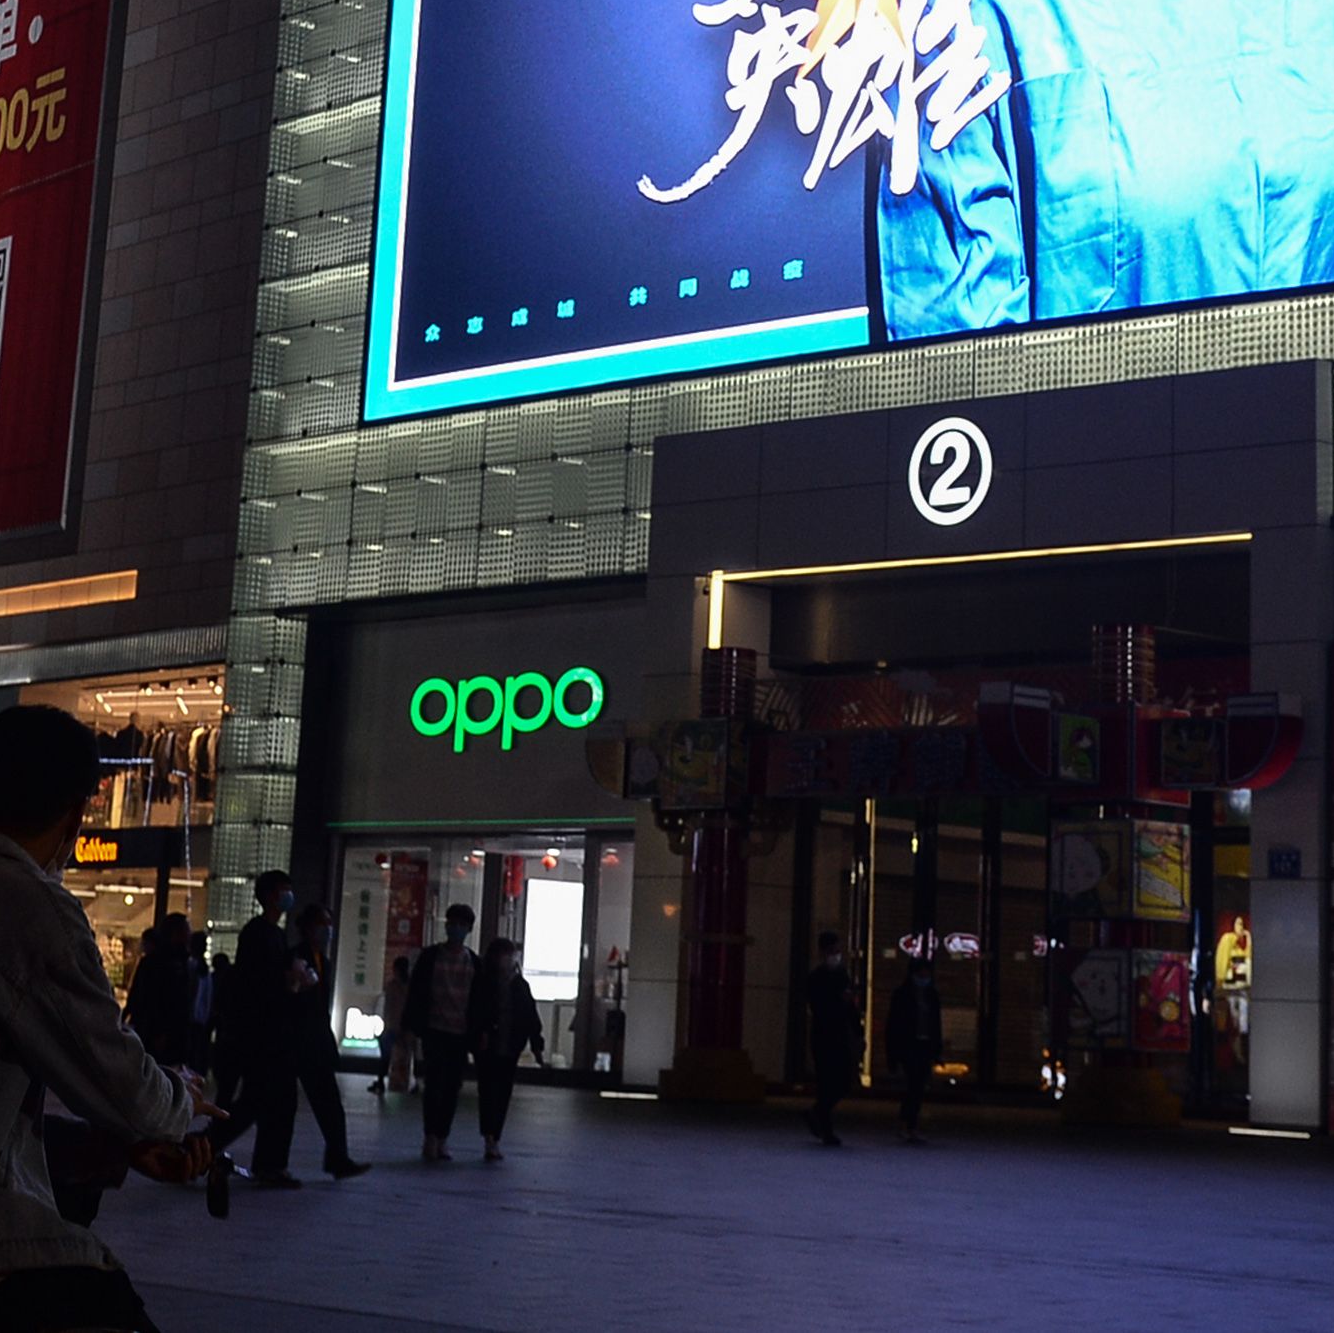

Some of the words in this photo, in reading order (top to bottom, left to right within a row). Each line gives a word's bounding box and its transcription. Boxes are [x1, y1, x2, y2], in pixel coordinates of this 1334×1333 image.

[424, 298, 576, 343] 众志成城
[628, 257, 805, 308] 共同战疫
[410, 667, 604, 752] oppo
